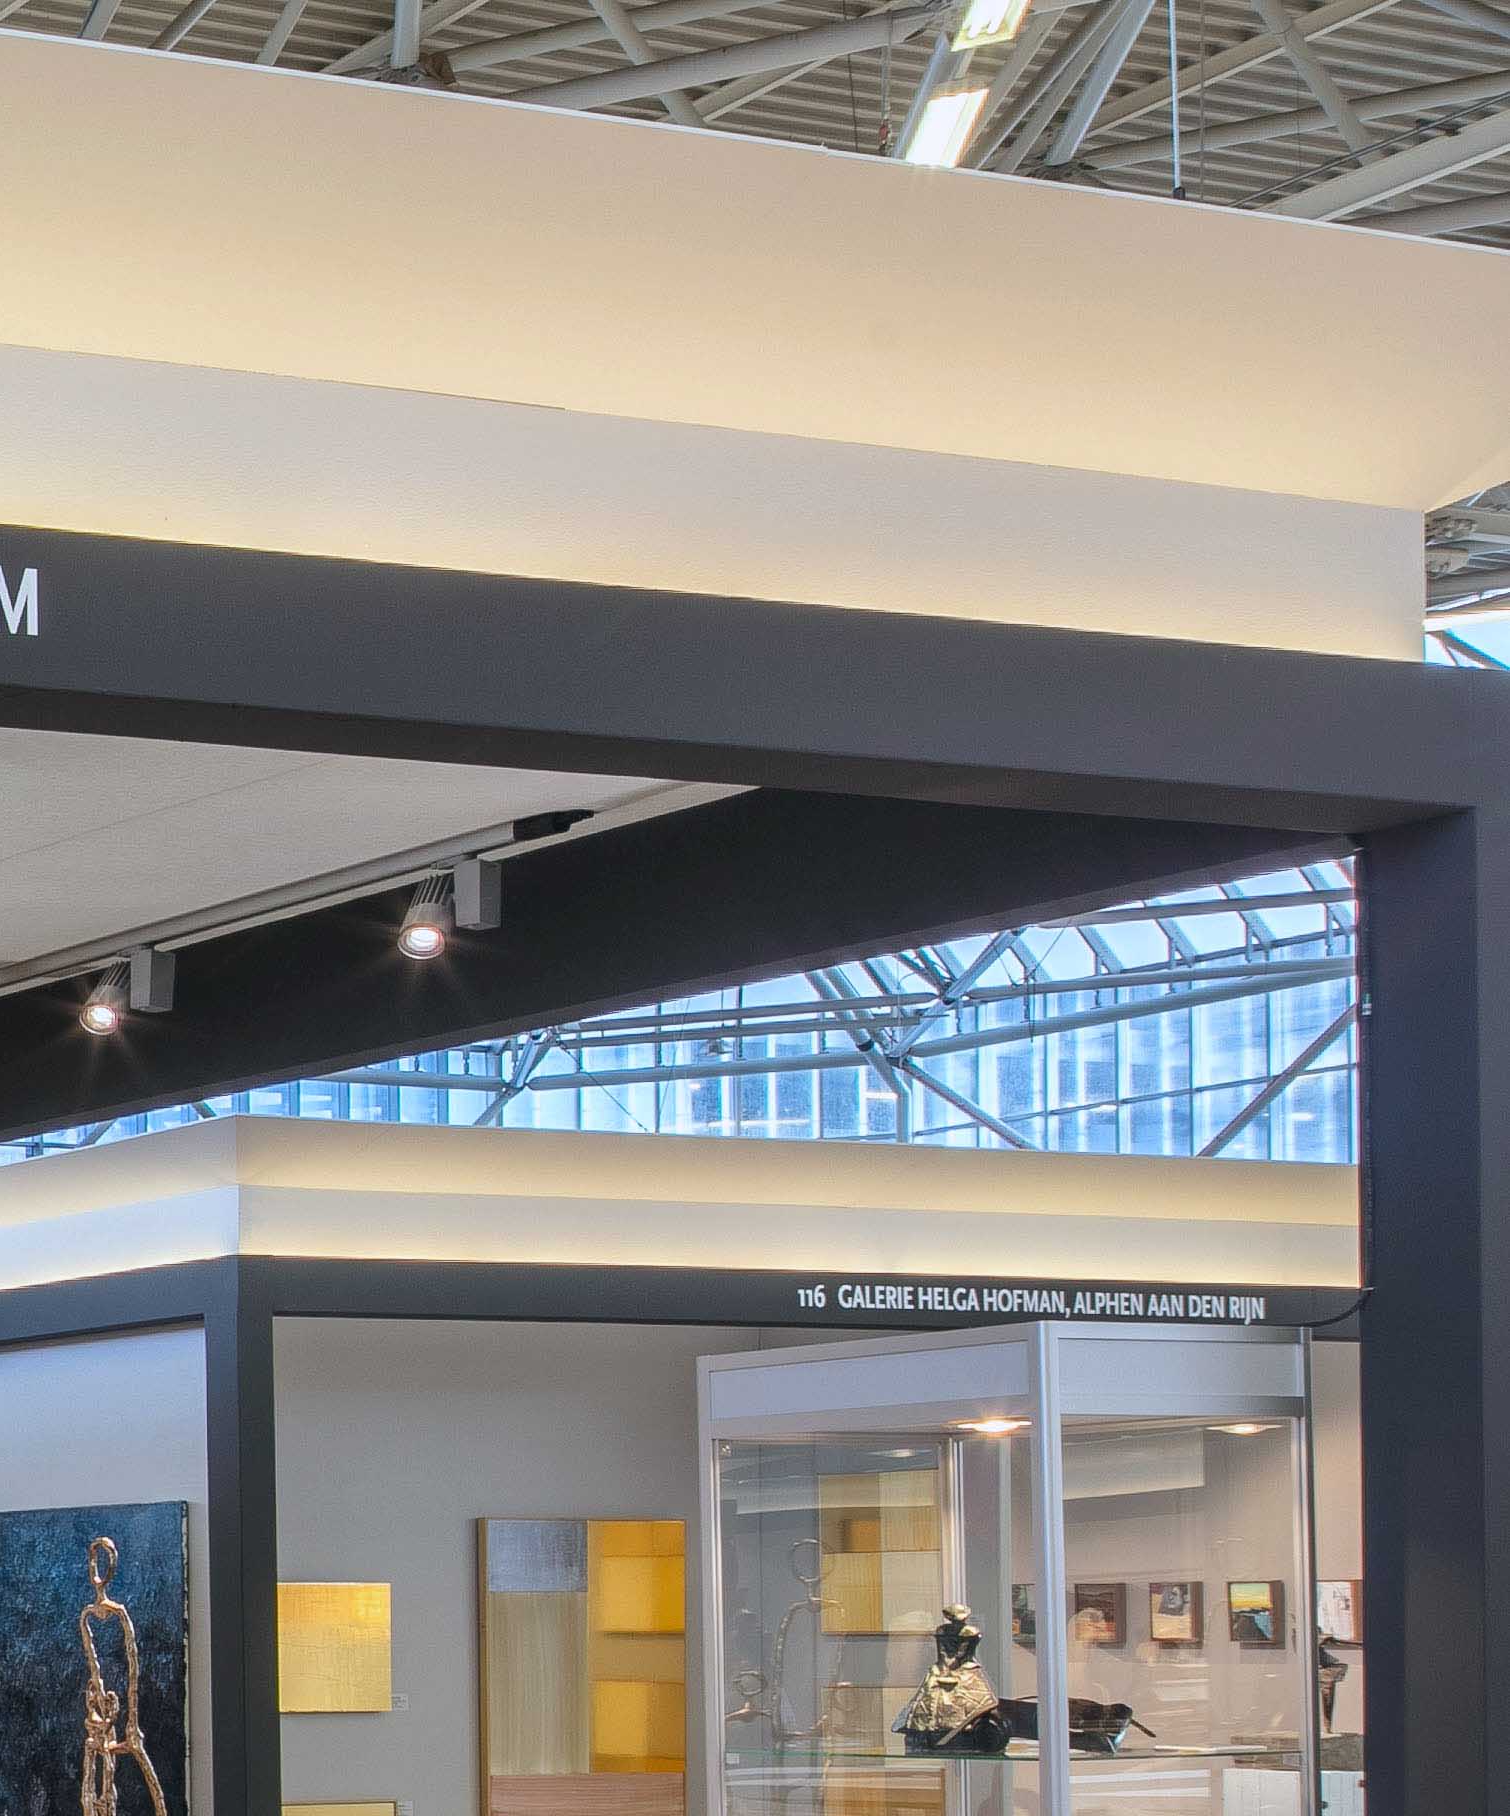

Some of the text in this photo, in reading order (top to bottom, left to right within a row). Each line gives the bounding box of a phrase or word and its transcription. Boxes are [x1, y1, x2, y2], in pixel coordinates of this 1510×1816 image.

[797, 1284, 1265, 1326] 116 GALERIE HELGA HOFMAN, ALPHEN AAN DEN RIJN
